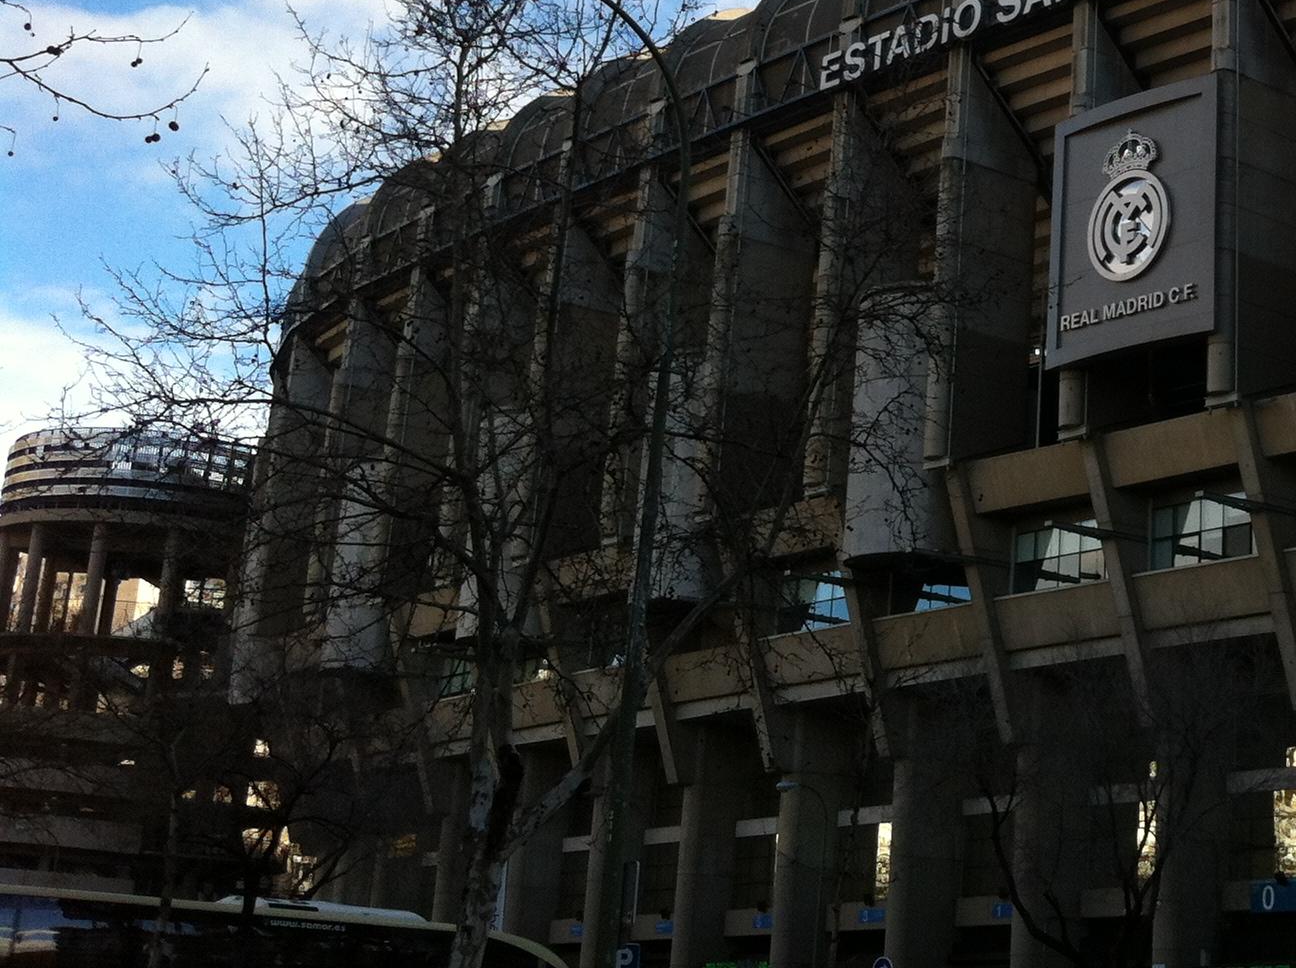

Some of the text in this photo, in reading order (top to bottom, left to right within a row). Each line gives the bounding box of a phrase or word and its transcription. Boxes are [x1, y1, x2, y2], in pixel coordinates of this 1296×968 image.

[1060, 308, 1099, 331] REAL
[1103, 290, 1164, 320] MADRID
[616, 948, 633, 968] P
